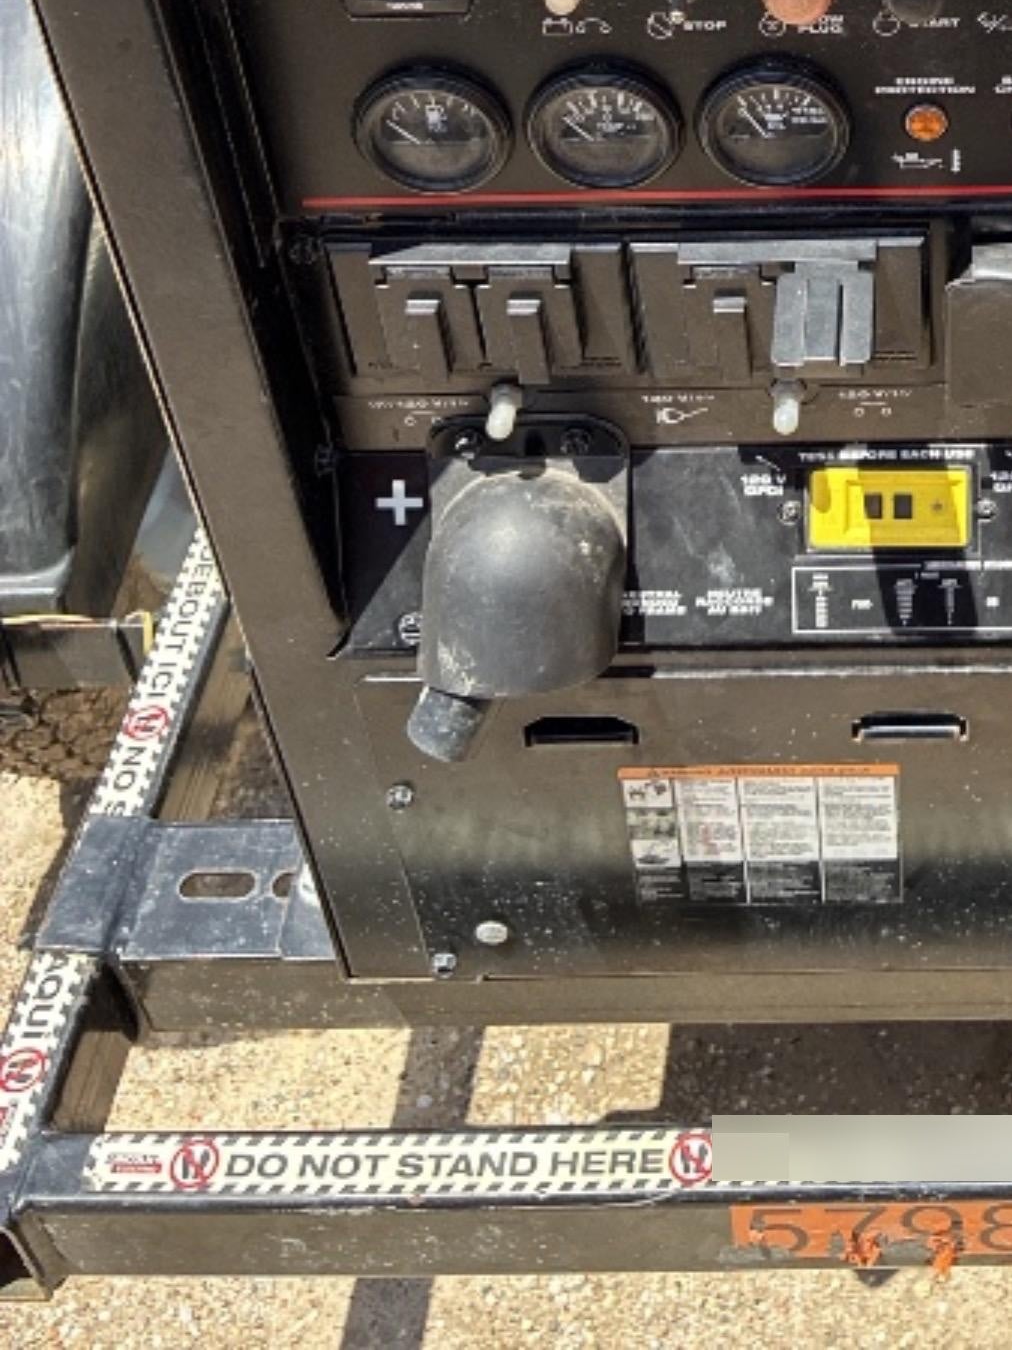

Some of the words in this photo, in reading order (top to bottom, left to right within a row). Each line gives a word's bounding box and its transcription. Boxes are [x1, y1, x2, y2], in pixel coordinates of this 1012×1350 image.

[683, 20, 727, 32] STOP
[838, 450, 897, 460] BEFORE
[900, 450, 940, 460] EACH
[112, 746, 148, 792] NO
[225, 1154, 290, 1179] DO
[298, 1153, 389, 1178] NOT
[395, 1151, 539, 1176] STAND
[549, 1149, 664, 1174] HERE
